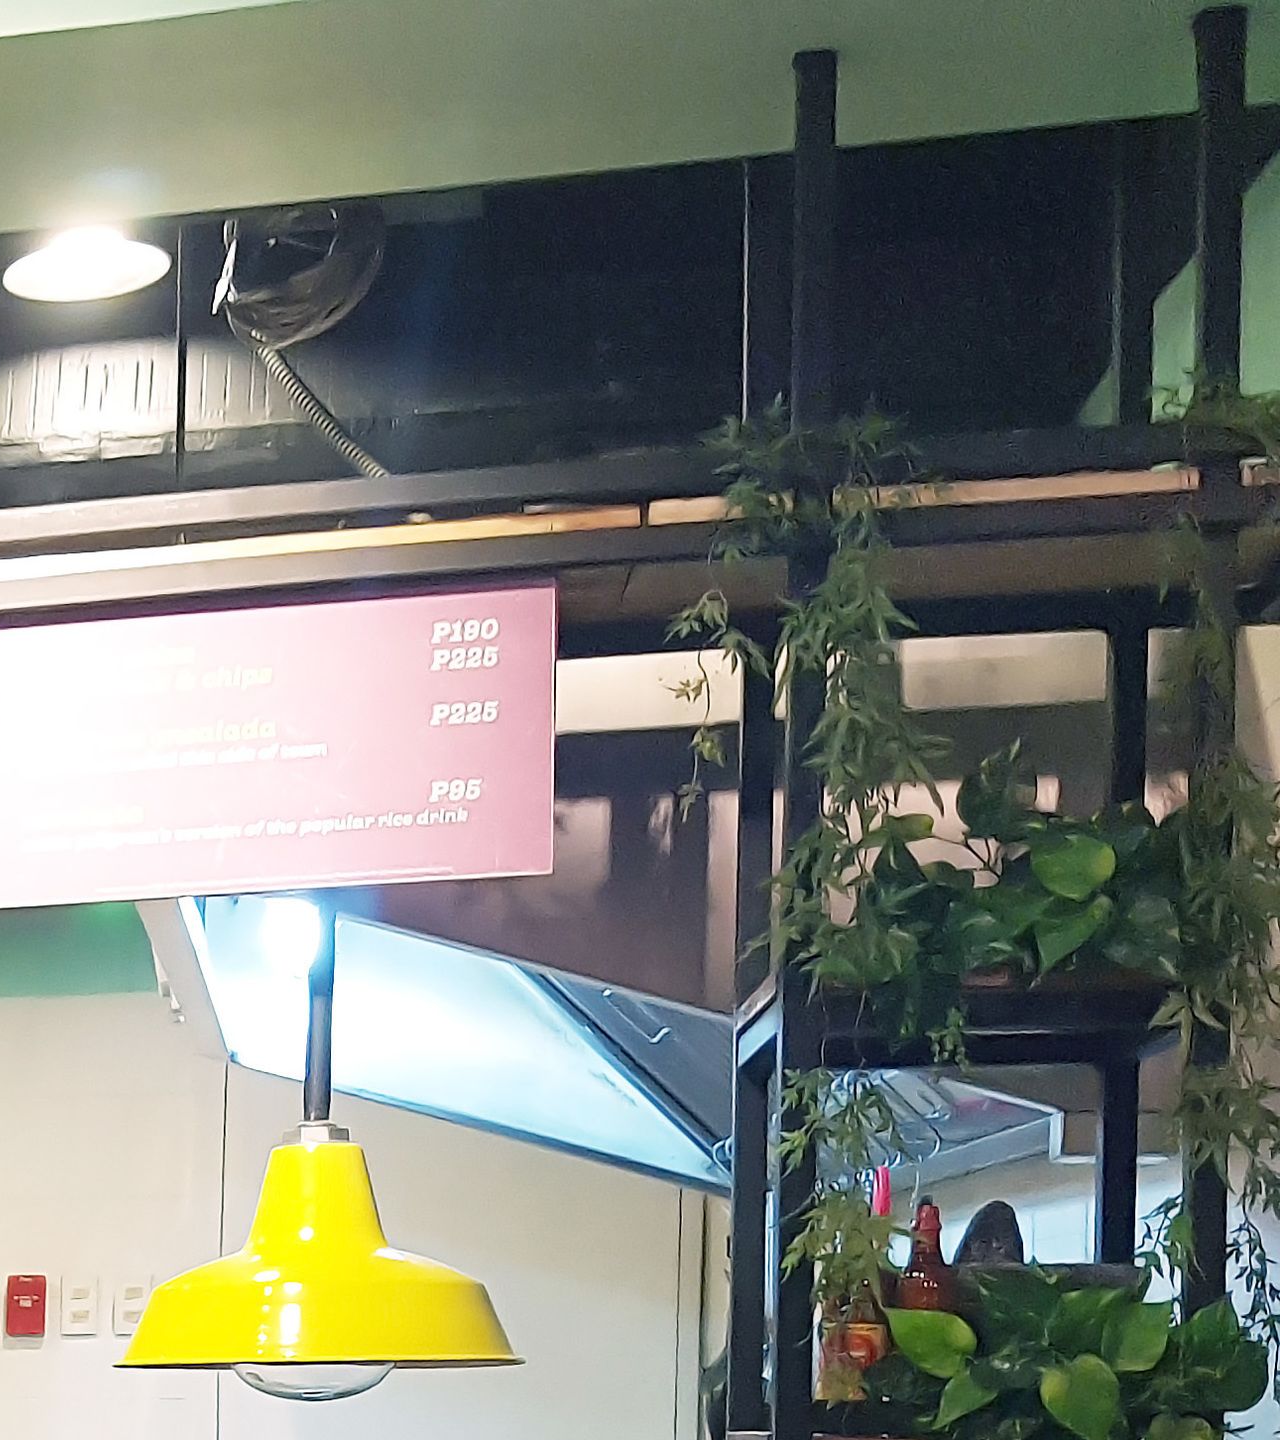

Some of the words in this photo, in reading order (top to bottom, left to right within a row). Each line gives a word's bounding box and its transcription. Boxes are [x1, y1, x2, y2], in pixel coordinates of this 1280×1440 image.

[429, 645, 500, 672] P225
[429, 699, 499, 726] P225
[427, 777, 484, 804] P95
[298, 812, 376, 838] popular
[378, 810, 413, 828] rice
[415, 806, 469, 826] drink
